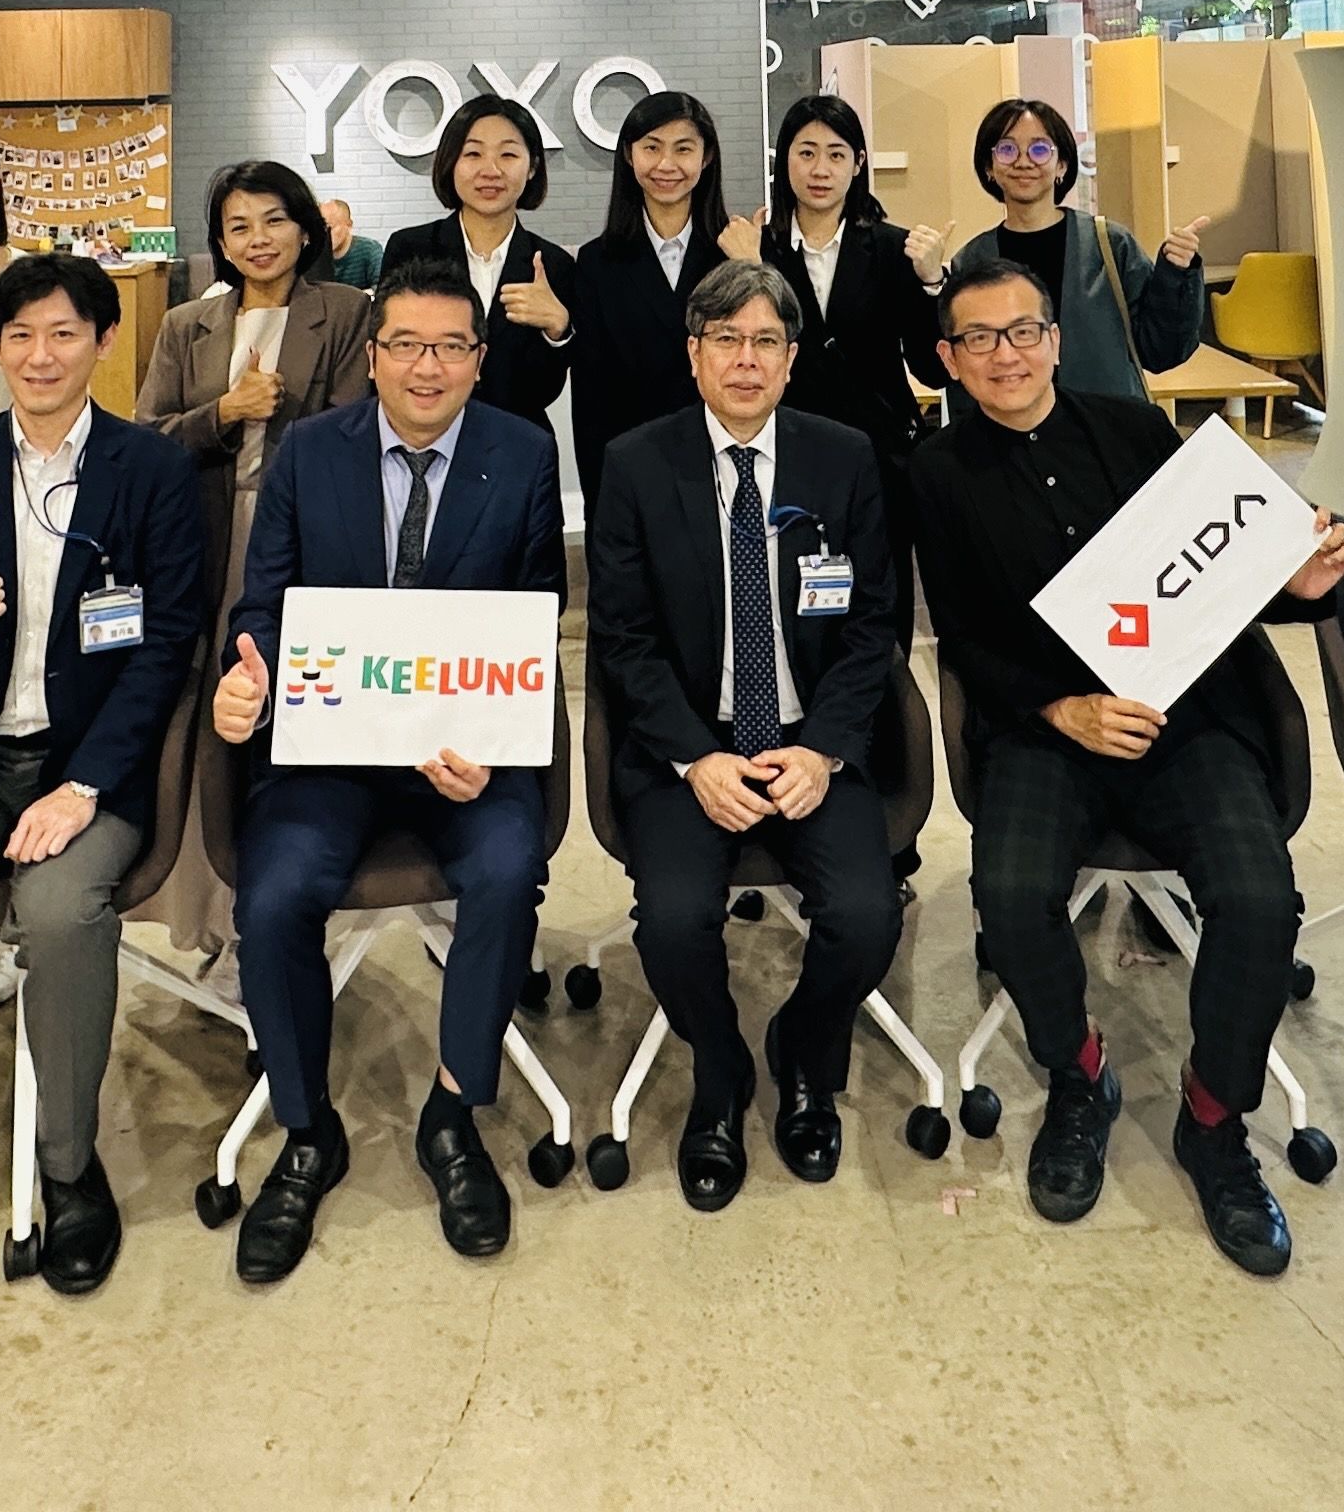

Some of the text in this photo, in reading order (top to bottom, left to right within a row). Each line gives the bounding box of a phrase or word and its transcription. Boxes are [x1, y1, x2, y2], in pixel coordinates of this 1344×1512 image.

[270, 55, 669, 158] YOXO
[1156, 493, 1267, 599] CIDA
[361, 654, 545, 697] KEELUNG
